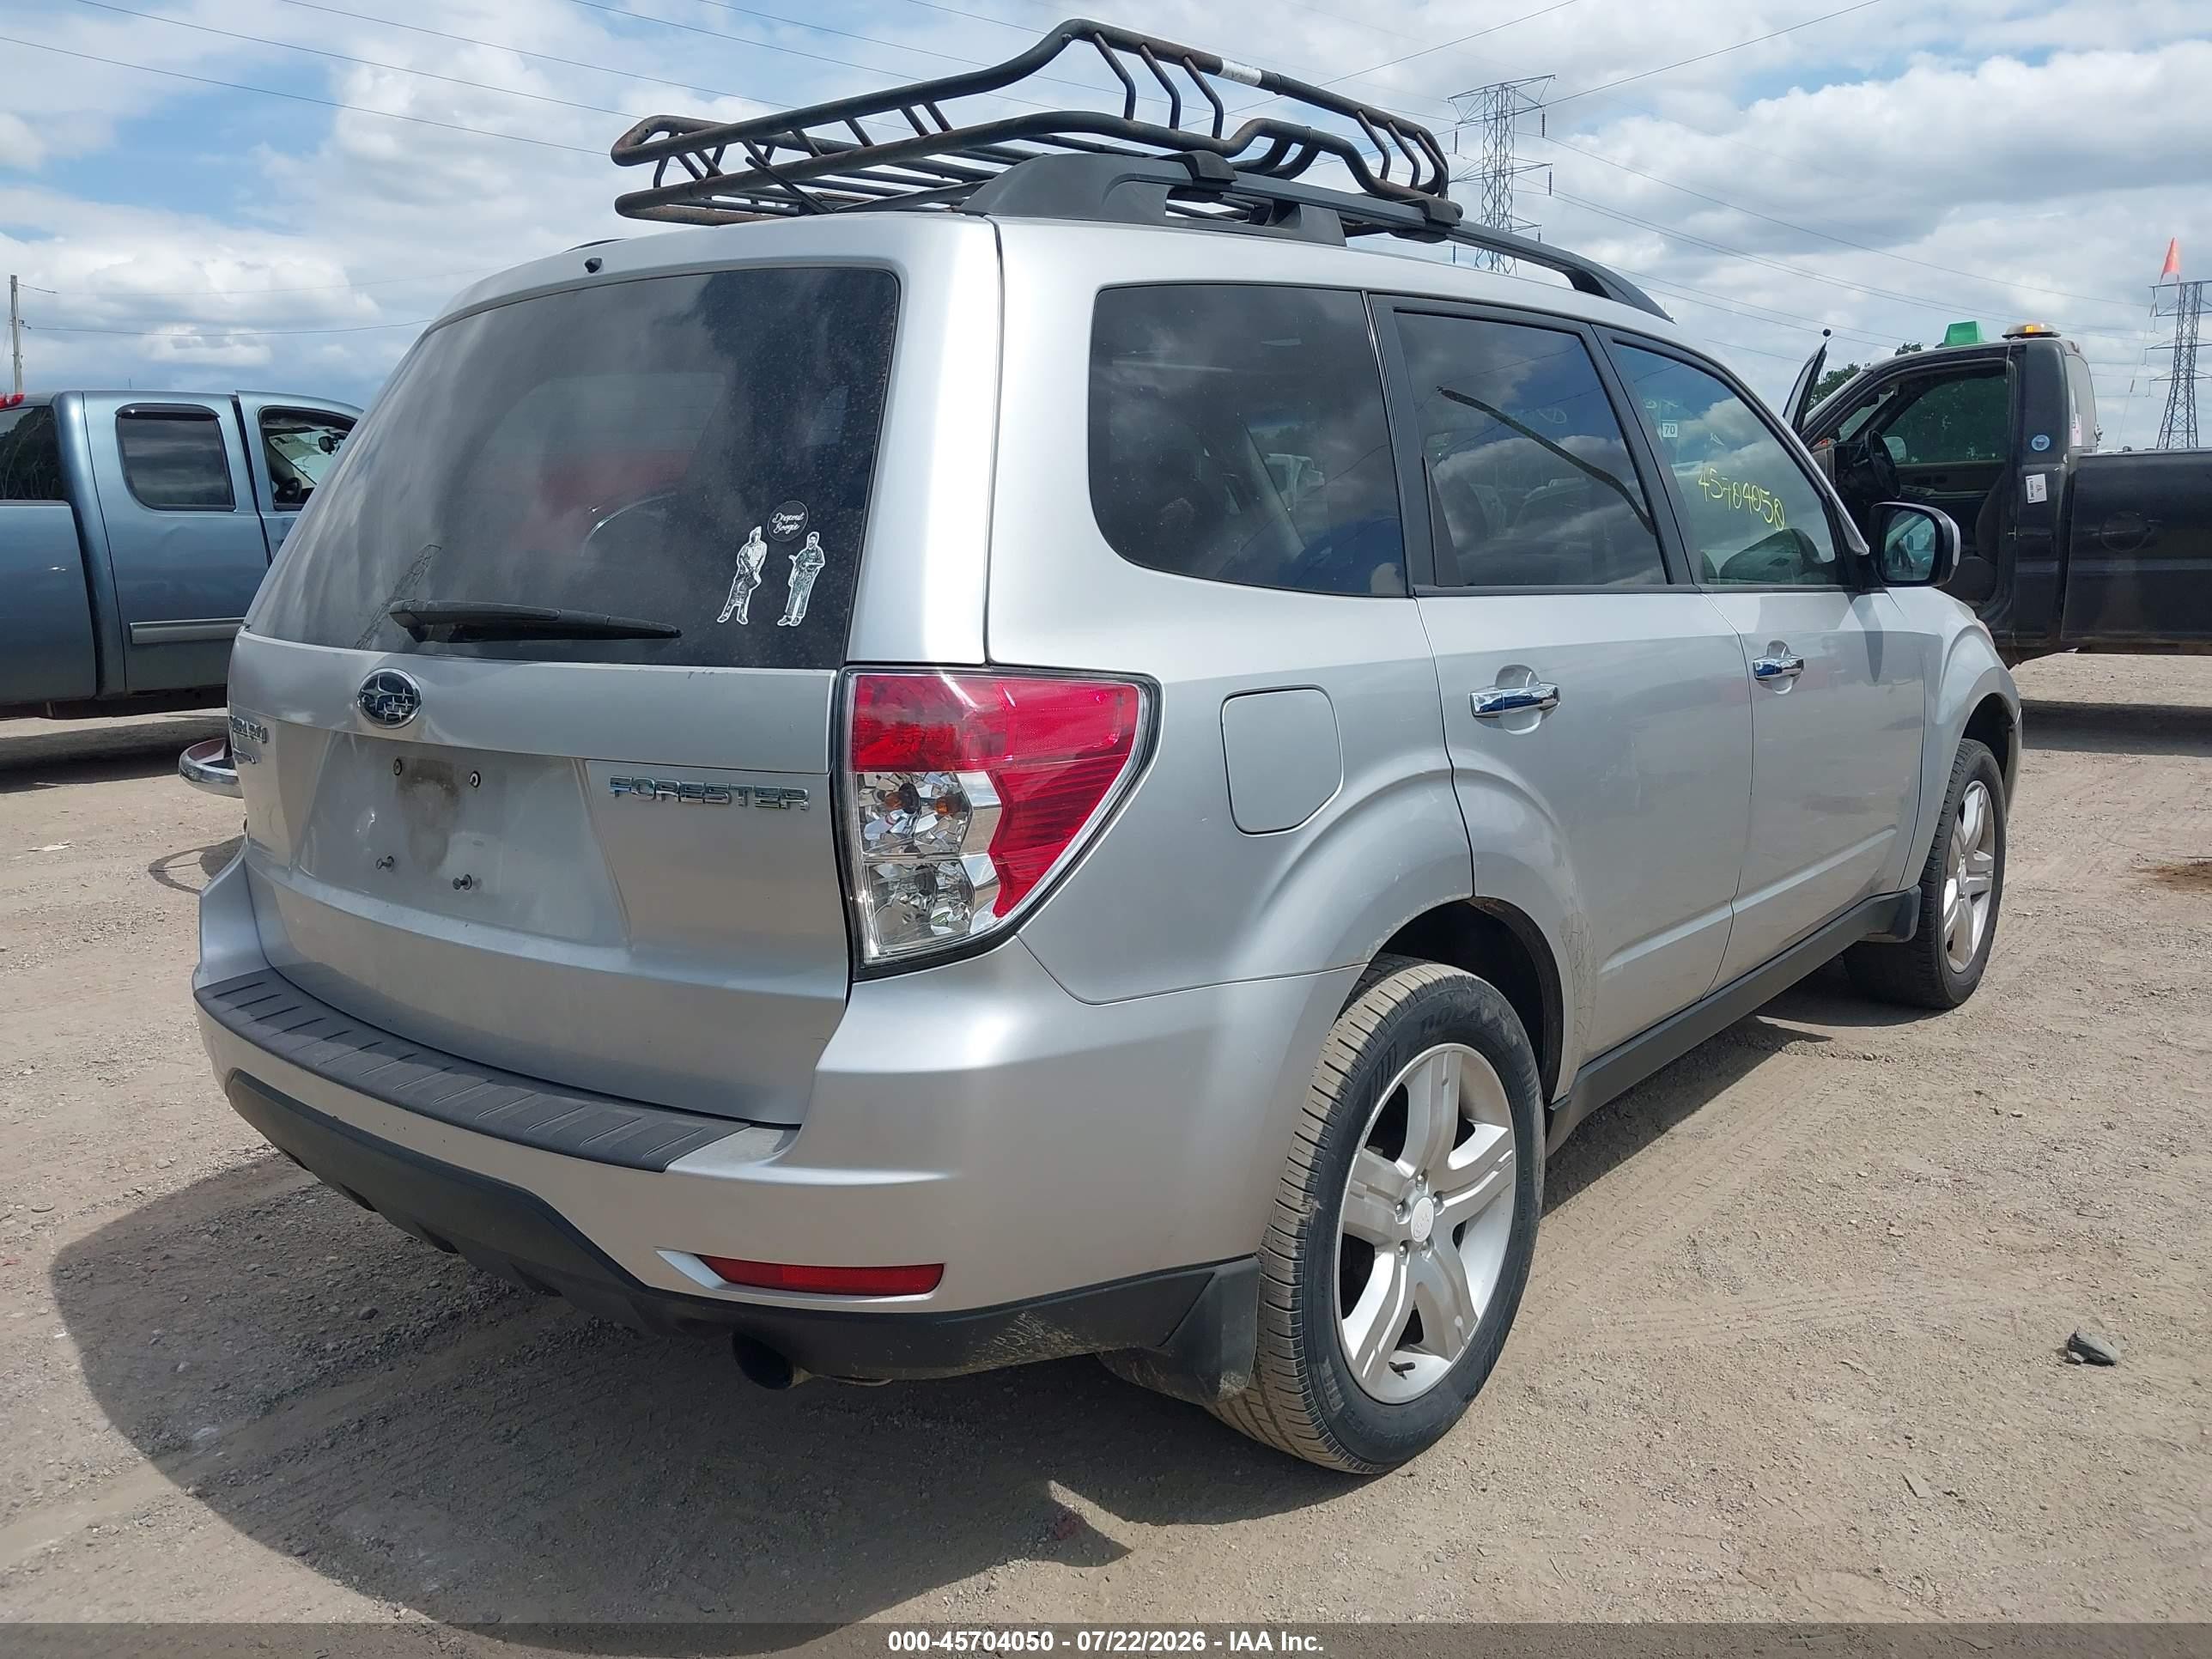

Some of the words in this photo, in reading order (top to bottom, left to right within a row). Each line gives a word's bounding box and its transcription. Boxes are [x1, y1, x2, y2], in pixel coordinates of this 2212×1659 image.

[1664, 425, 1675, 434] 70
[774, 521, 800, 534] Boogie
[609, 775, 810, 811] FORESTER
